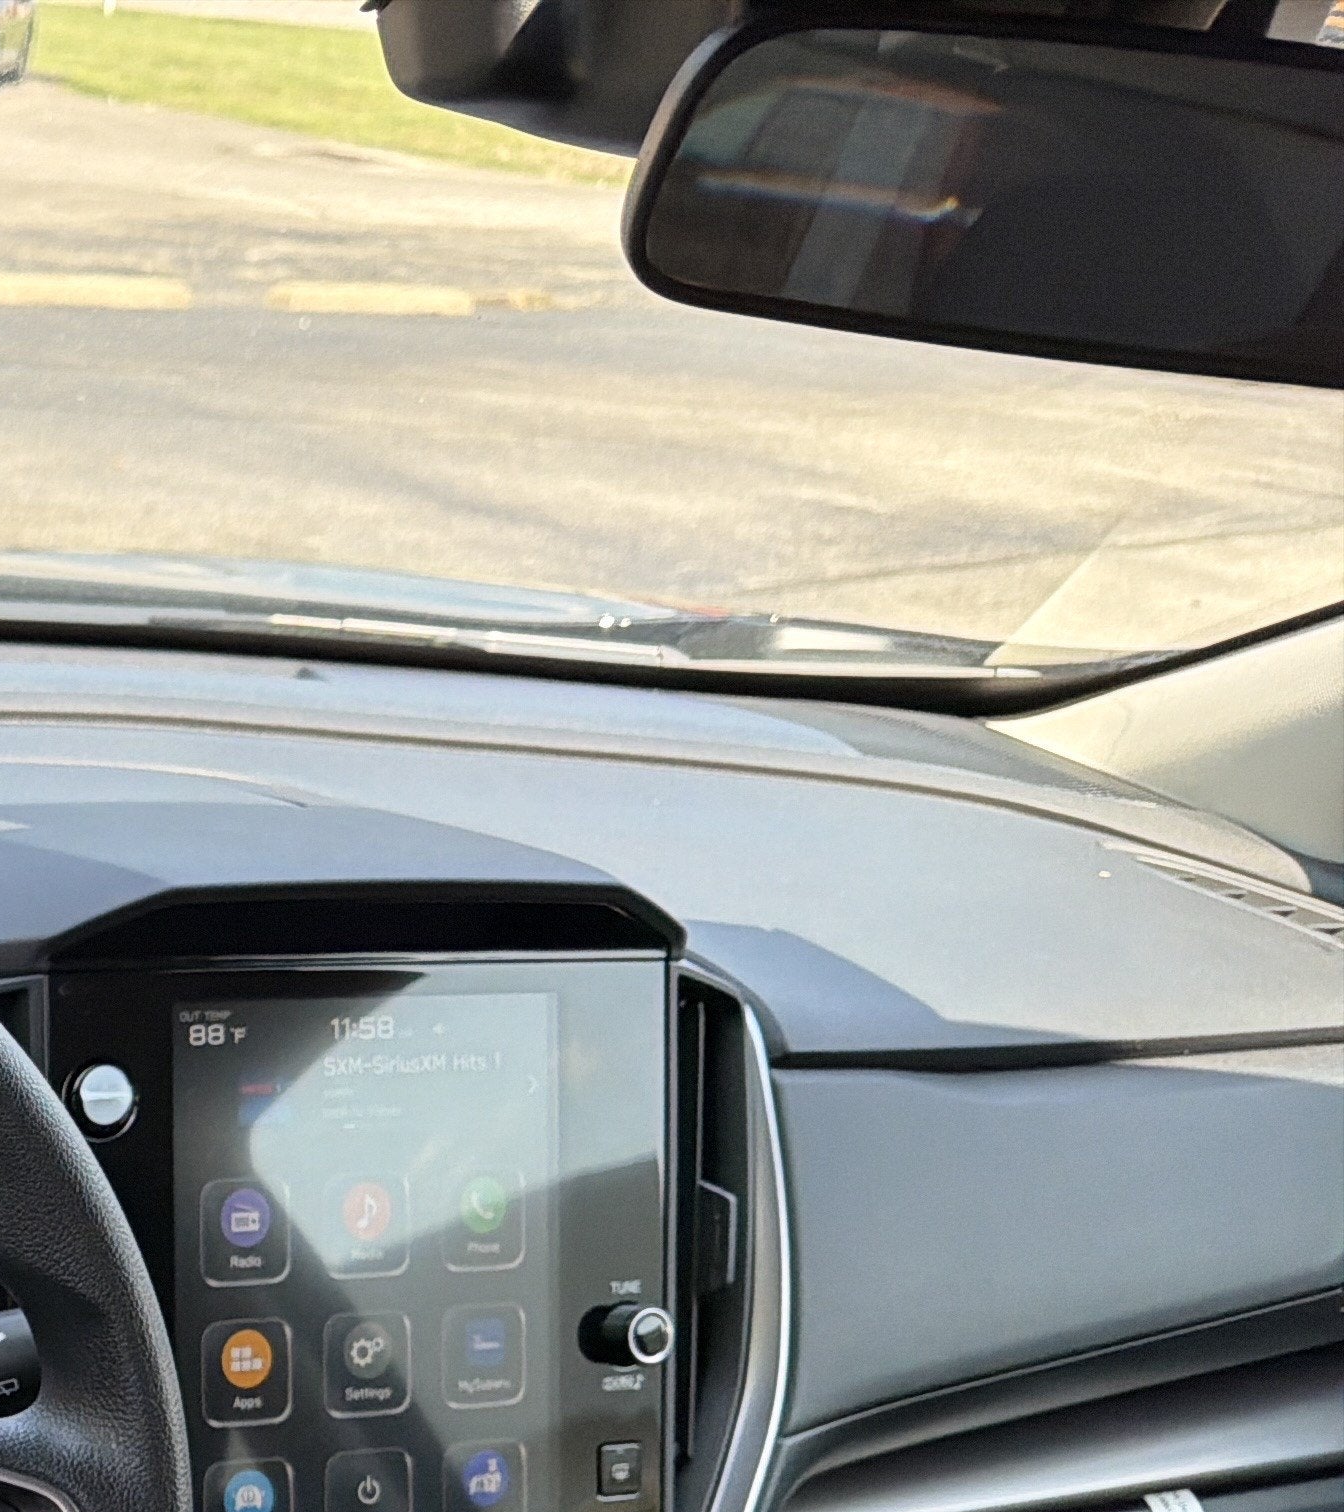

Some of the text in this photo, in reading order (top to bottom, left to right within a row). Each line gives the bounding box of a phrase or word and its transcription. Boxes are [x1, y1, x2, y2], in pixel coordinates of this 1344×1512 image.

[188, 1023, 226, 1047] 88
[330, 1015, 395, 1041] 11:58
[322, 1053, 447, 1078] SXM-SiriusXM
[452, 1052, 487, 1072] Hits
[229, 1255, 262, 1269] Radio
[232, 1396, 262, 1411] Apps
[344, 1385, 393, 1402] Settings
